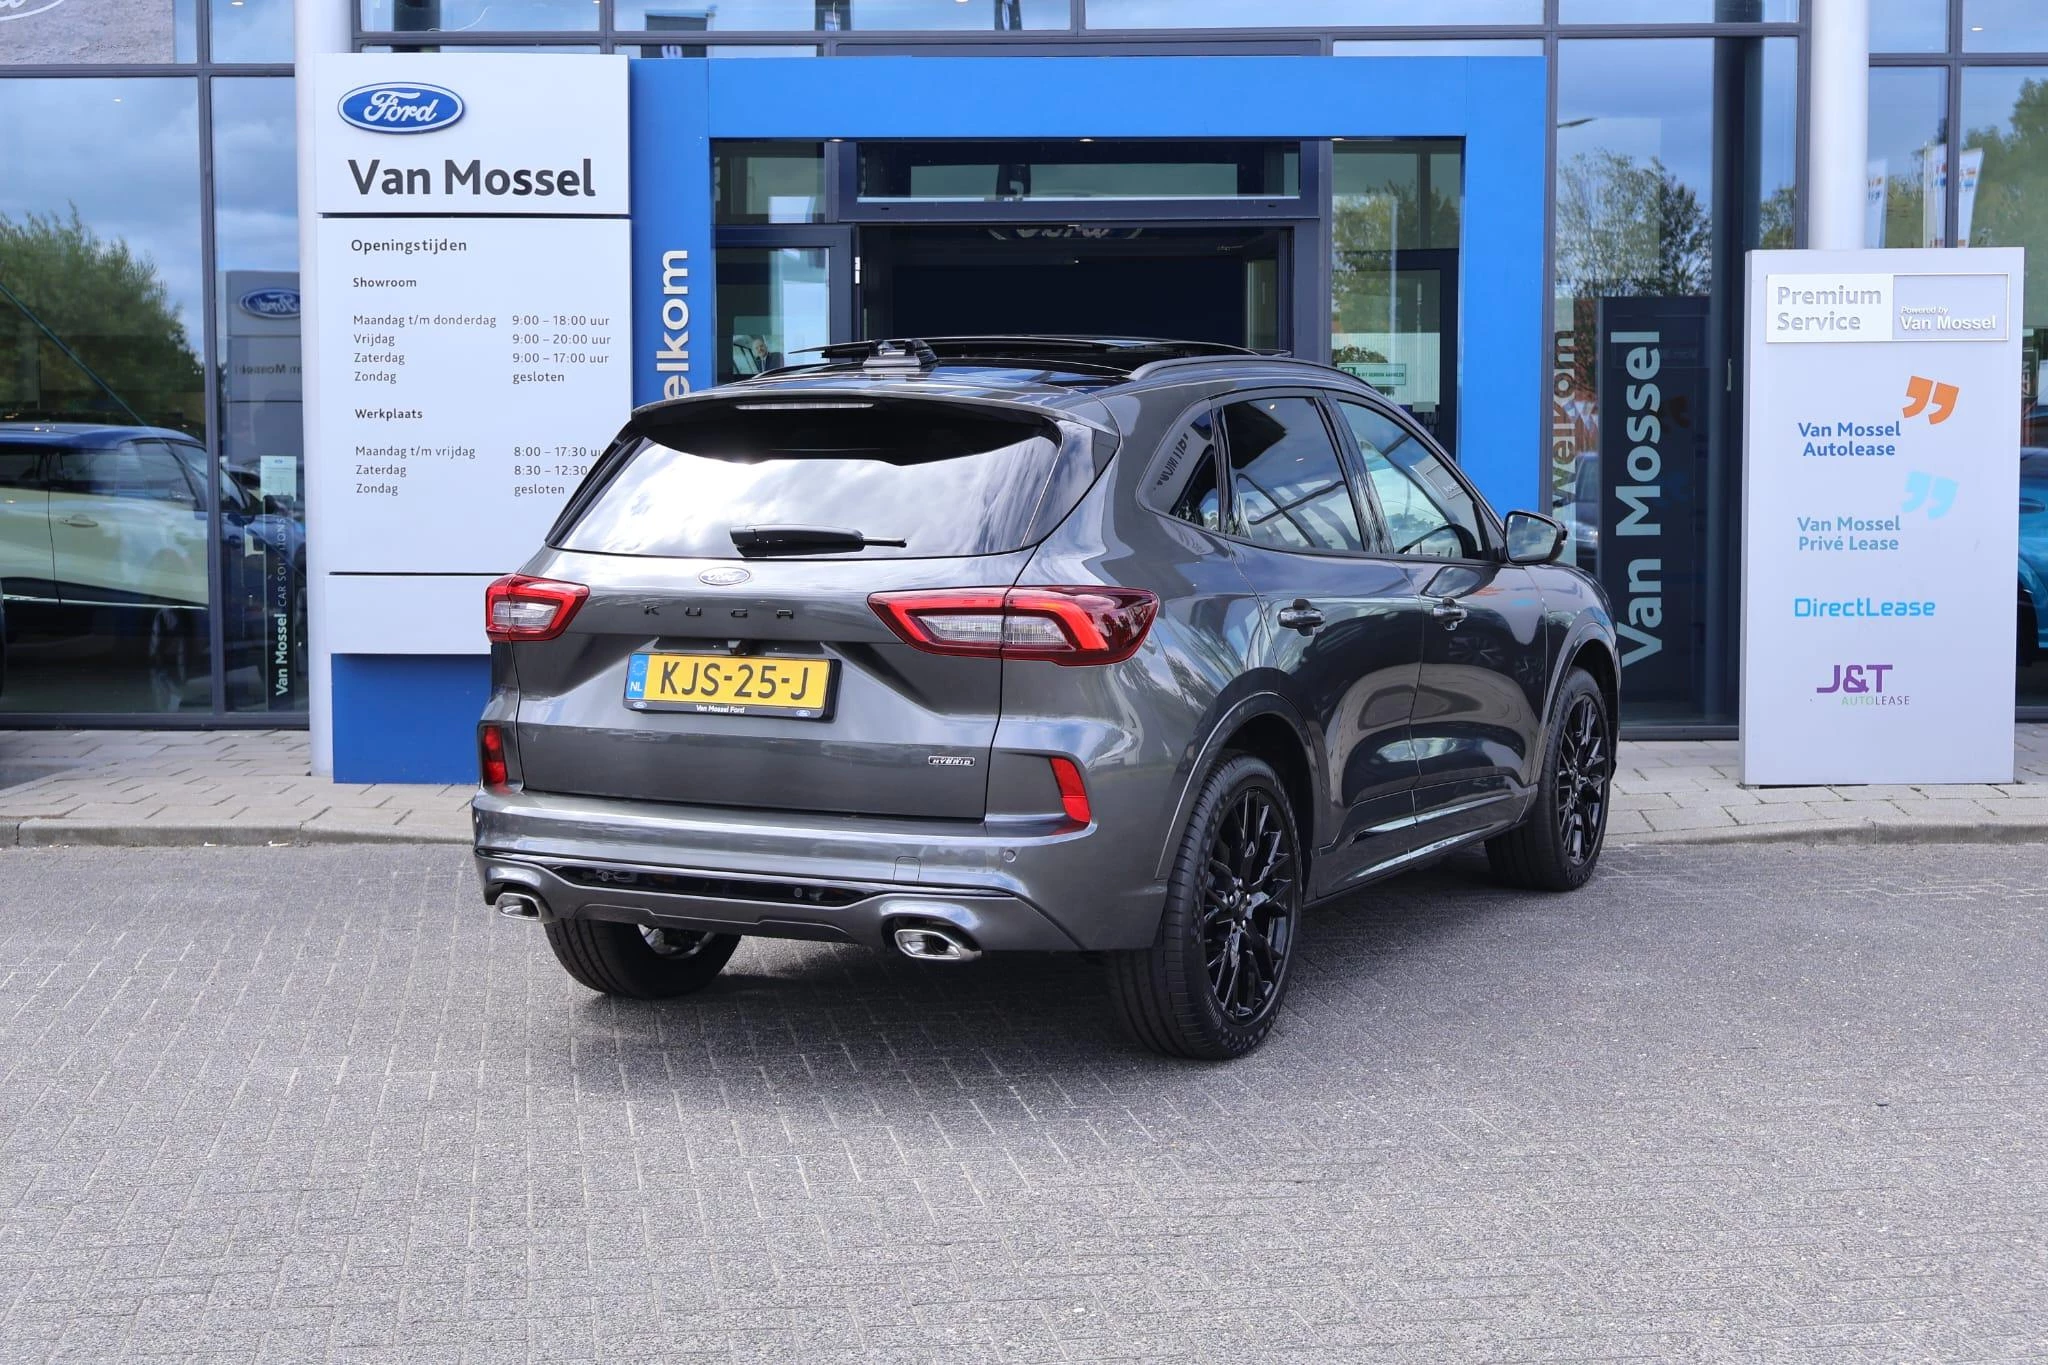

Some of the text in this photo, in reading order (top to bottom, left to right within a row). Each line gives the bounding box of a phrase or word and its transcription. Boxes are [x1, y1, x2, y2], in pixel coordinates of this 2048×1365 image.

[362, 89, 440, 123] Ford
[348, 158, 596, 197] Van Mossel
[351, 239, 467, 255] Openingstijden
[353, 277, 417, 288] Showroom
[1776, 285, 1882, 305] Premium
[353, 315, 496, 328] Maandag t/m donderdag
[512, 315, 539, 325] 9:00
[553, 315, 586, 325] 18:00
[590, 317, 610, 325] uur
[656, 250, 690, 400] elkom
[1776, 311, 1861, 330] Service
[1900, 315, 1996, 330] Van Mossel
[353, 333, 395, 347] Vrijdag
[512, 334, 539, 344] 9:00
[553, 334, 587, 344] 20:00
[591, 336, 611, 344] uur
[353, 352, 405, 365] Zaterdag
[512, 353, 540, 363] 9:00
[553, 353, 585, 363] 17:00
[589, 355, 609, 363] uur
[354, 371, 397, 384] Zondag
[512, 371, 565, 385] gesloten
[355, 408, 423, 422] Werkplaats
[1798, 421, 1901, 437] Van Mossel
[355, 446, 476, 459] Maandag t/m vrijdag
[514, 447, 541, 456] 8:00
[554, 447, 587, 456] 17:30
[1803, 441, 1895, 456] Autolease
[355, 464, 407, 477] Zaterdag
[514, 465, 541, 475] 8:30
[555, 465, 588, 475] 12:30
[356, 483, 399, 496] Zondag
[514, 484, 565, 497] gesloten
[1610, 331, 1662, 668] Van Mossel
[1797, 516, 1901, 531] Van Mossel
[1799, 536, 1899, 550] Privé Lease
[273, 518, 288, 696] Van Mossel CAR SOLIONS
[1794, 598, 1936, 617] DirectLease
[629, 661, 809, 700] NL KJS-25-J
[1816, 665, 1893, 693] J&T
[1841, 695, 1910, 706] AUTOLEASE
[696, 704, 708, 712] Van
[932, 757, 971, 766] HYBRID
